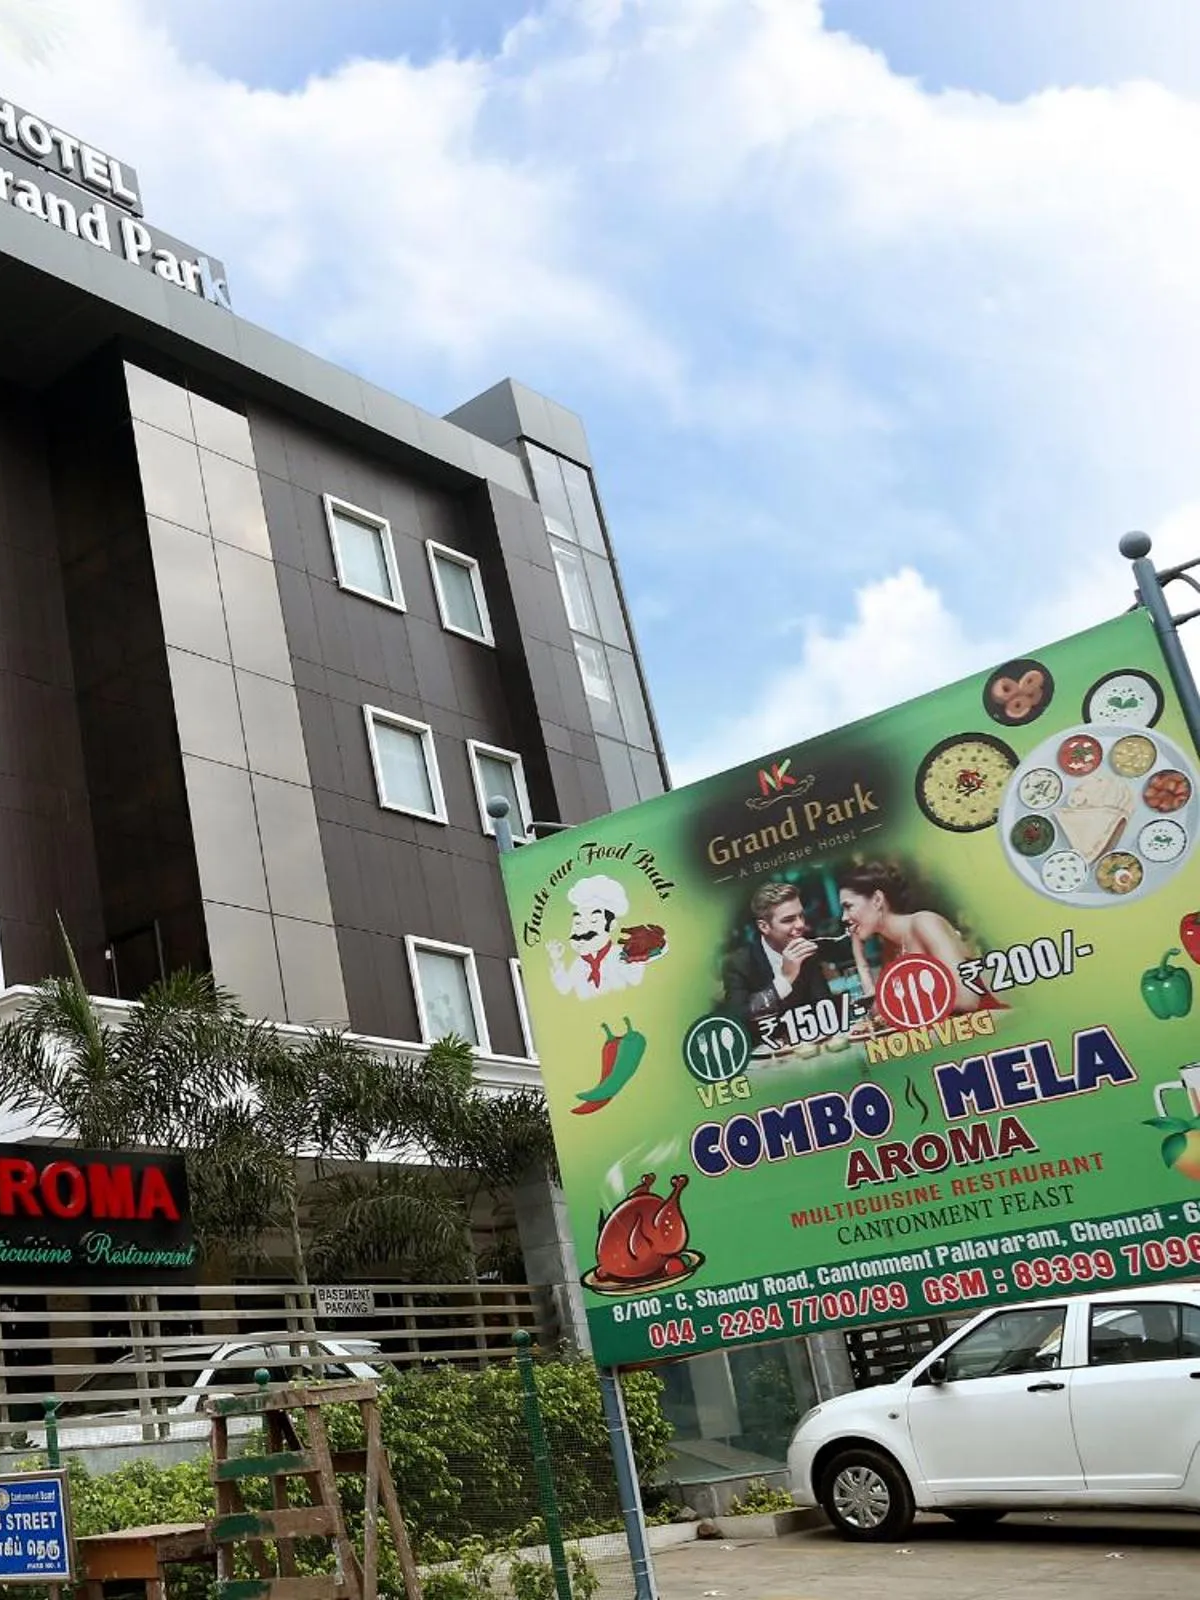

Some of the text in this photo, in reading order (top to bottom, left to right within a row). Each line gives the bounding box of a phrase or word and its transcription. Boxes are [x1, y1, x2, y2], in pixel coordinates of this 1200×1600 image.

[119, 215, 233, 310] Park
[757, 758, 797, 797] NK
[708, 782, 879, 866] Grand Park
[753, 844, 812, 874] Boutique
[818, 830, 857, 851] Hotel
[523, 842, 675, 947] Taste our Food Buds
[864, 1010, 997, 1065] NON VEG
[690, 1025, 1139, 1177] COMBO MELA
[696, 1075, 752, 1110] VEG
[845, 1115, 1040, 1189] AROMA
[790, 1152, 1105, 1230] MULTICUISINE RESTAURANT
[837, 1185, 1075, 1246] CANTONMENT FEAST
[82, 1231, 197, 1266] Restaurant
[612, 1299, 662, 1323] 8/100
[674, 1293, 693, 1312] C,
[696, 1281, 759, 1308] Shandy
[764, 1271, 815, 1296] Road,
[817, 1252, 933, 1287] Cantonment
[937, 1228, 1068, 1267] Pallavaram,
[1070, 1208, 1165, 1243] Chennai
[1182, 1201, 1200, 1224] 6
[318, 1289, 370, 1301] BASEMENT
[324, 1302, 368, 1313] PARKING
[649, 1318, 696, 1348] 044
[718, 1304, 785, 1340] 2264
[787, 1282, 909, 1326] 7700/99
[922, 1267, 989, 1305] GSM
[1012, 1249, 1116, 1291] 89399
[1120, 1232, 1200, 1276] 7096
[6, 1511, 57, 1530] STREET
[26, 1539, 61, 1561] தெரு
